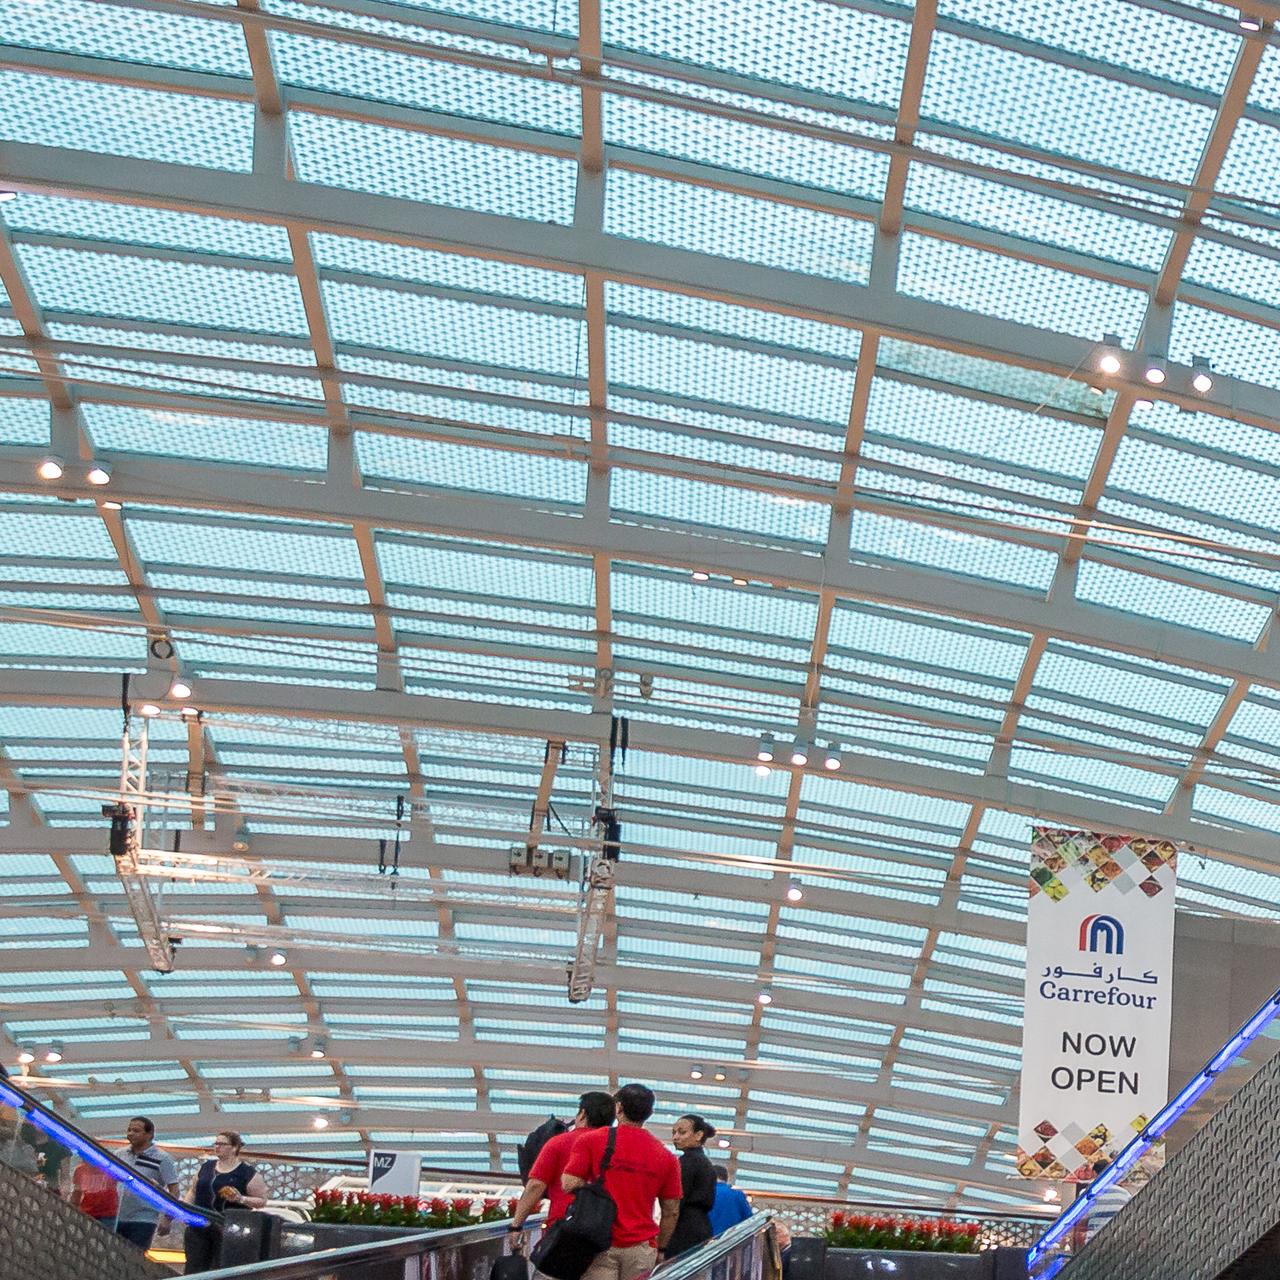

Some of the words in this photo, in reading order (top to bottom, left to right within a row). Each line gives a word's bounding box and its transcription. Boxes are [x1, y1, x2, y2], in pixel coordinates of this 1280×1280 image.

[1041, 961, 1158, 984] كارفور
[1039, 980, 1157, 1010] Carrefour
[1061, 1031, 1136, 1058] NOW
[1051, 1066, 1139, 1095] OPEN
[374, 1156, 392, 1169] MZ
